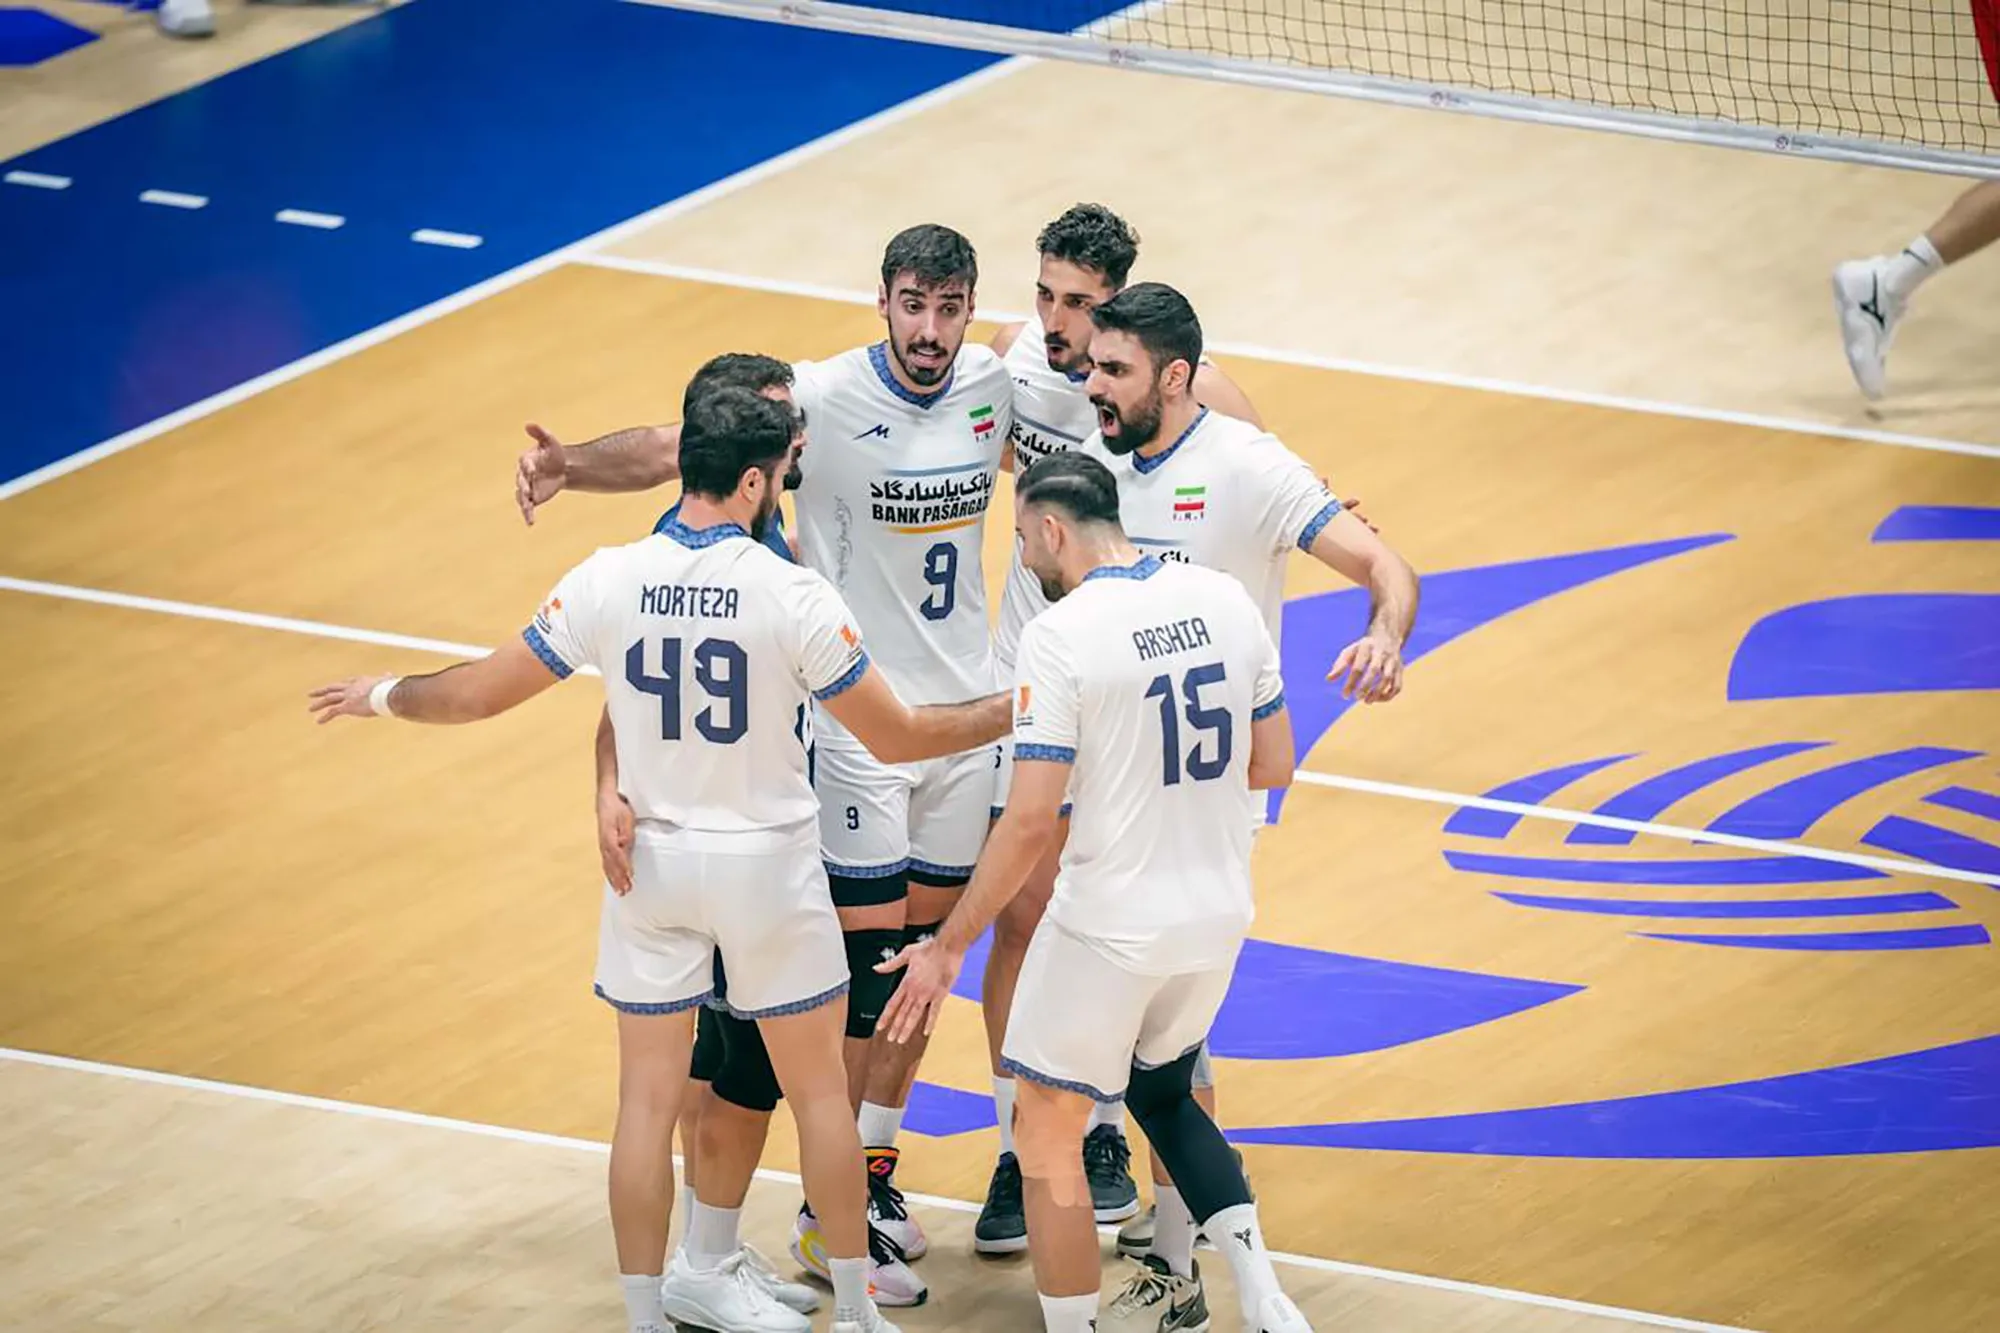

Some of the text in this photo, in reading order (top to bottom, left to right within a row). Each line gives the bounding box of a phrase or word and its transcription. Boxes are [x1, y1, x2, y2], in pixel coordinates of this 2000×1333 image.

[872, 503, 920, 524] BANK
[641, 584, 738, 618] MORTEZA
[920, 542, 958, 621] 9
[1132, 617, 1211, 661] ARSHIA
[625, 637, 748, 744] 49
[1144, 662, 1232, 786] 15
[847, 806, 860, 830] 9
